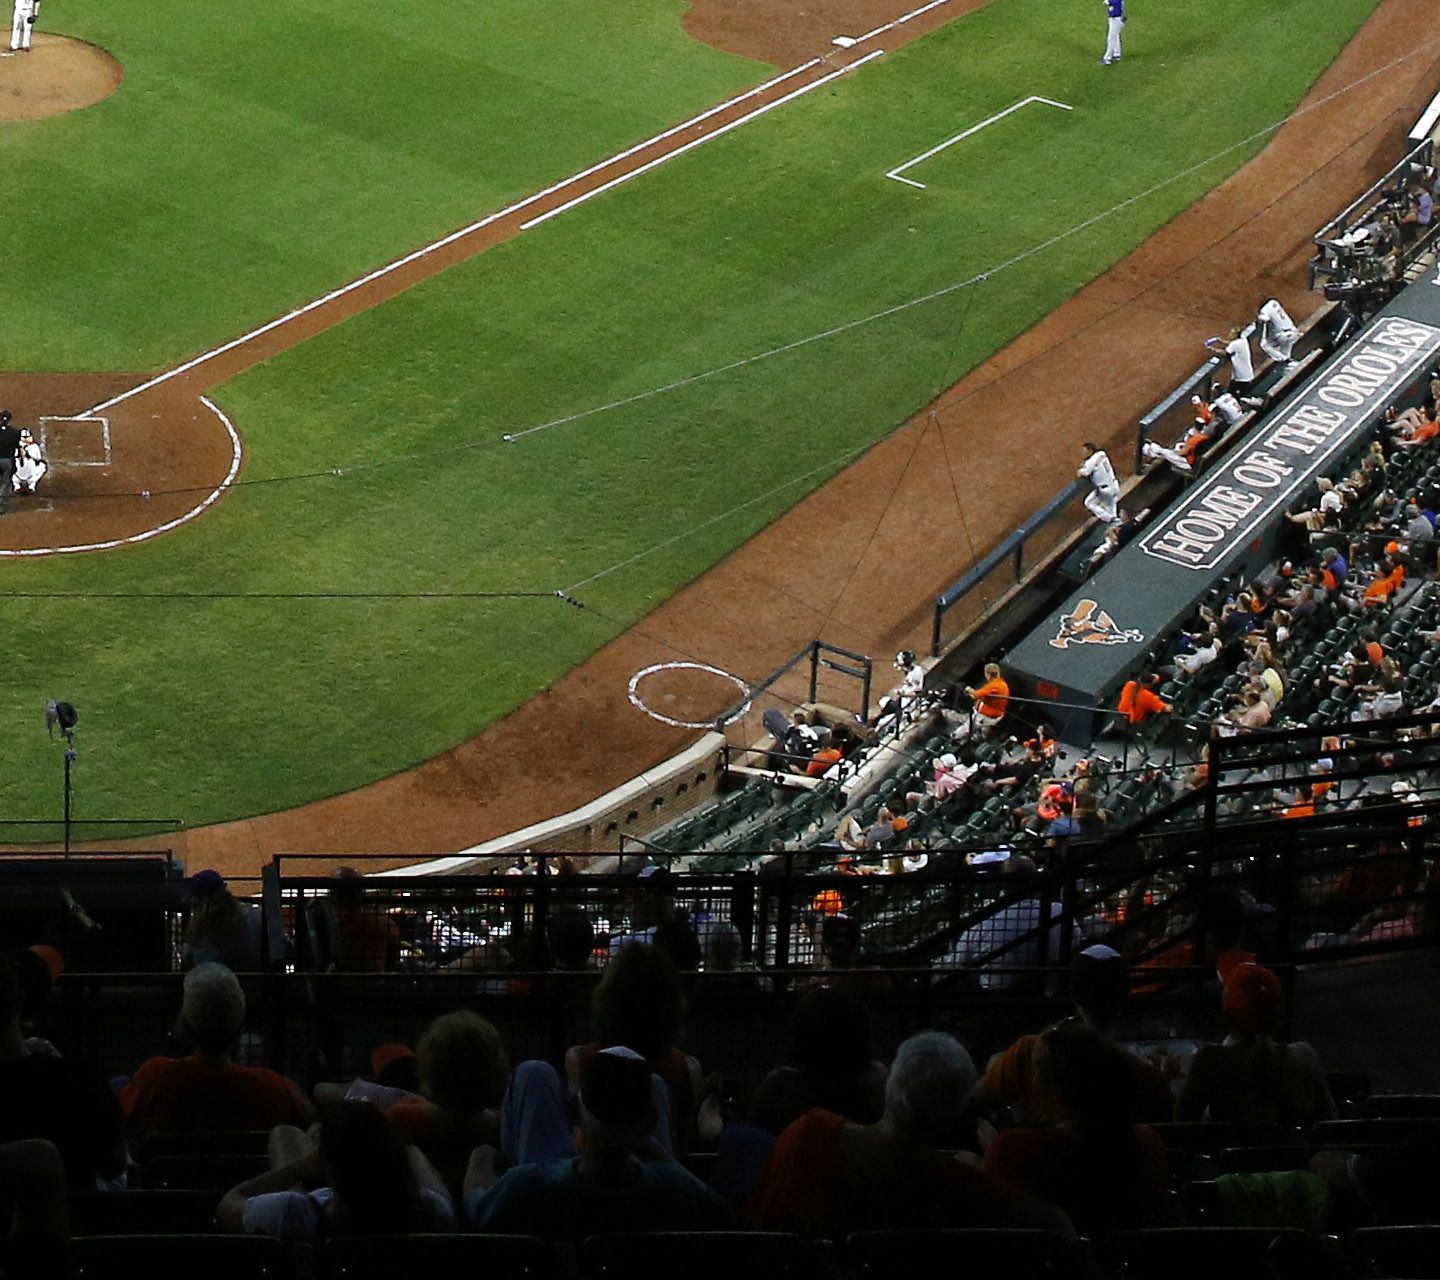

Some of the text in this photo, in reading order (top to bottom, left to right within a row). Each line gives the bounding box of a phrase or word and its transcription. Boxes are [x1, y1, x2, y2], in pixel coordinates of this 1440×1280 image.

[1152, 321, 1430, 561] HOME OF THE ORIOLES
